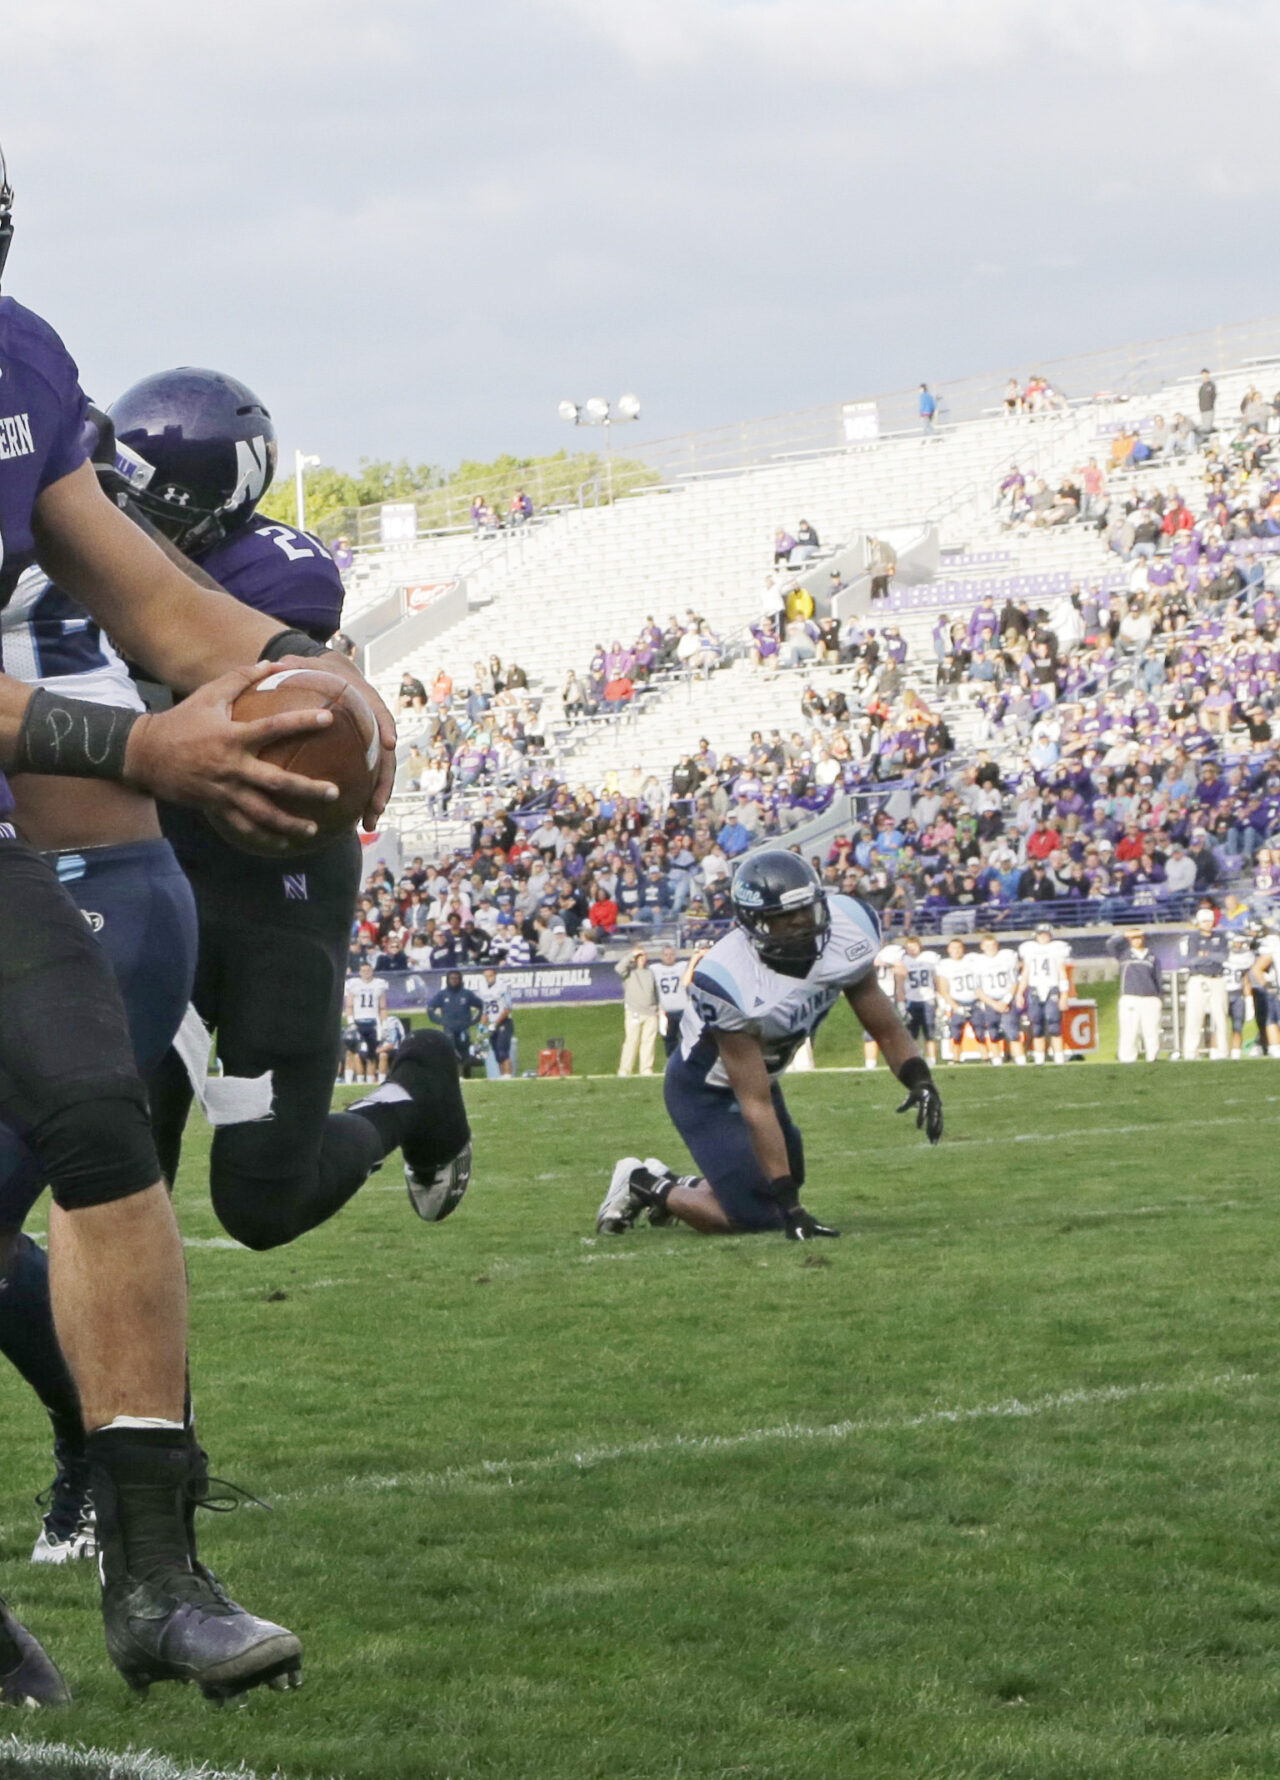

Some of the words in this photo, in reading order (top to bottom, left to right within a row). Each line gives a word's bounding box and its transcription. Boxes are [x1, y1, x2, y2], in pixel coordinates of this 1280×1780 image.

[232, 435, 267, 503] N
[283, 873, 308, 900] N
[1032, 958, 1051, 977] 14
[534, 969, 592, 987] FOOTBALL
[660, 976, 680, 994] 67
[908, 969, 930, 988] 58
[988, 971, 1008, 989] 10
[360, 993, 374, 1008] 11
[1071, 1013, 1091, 1045] G
